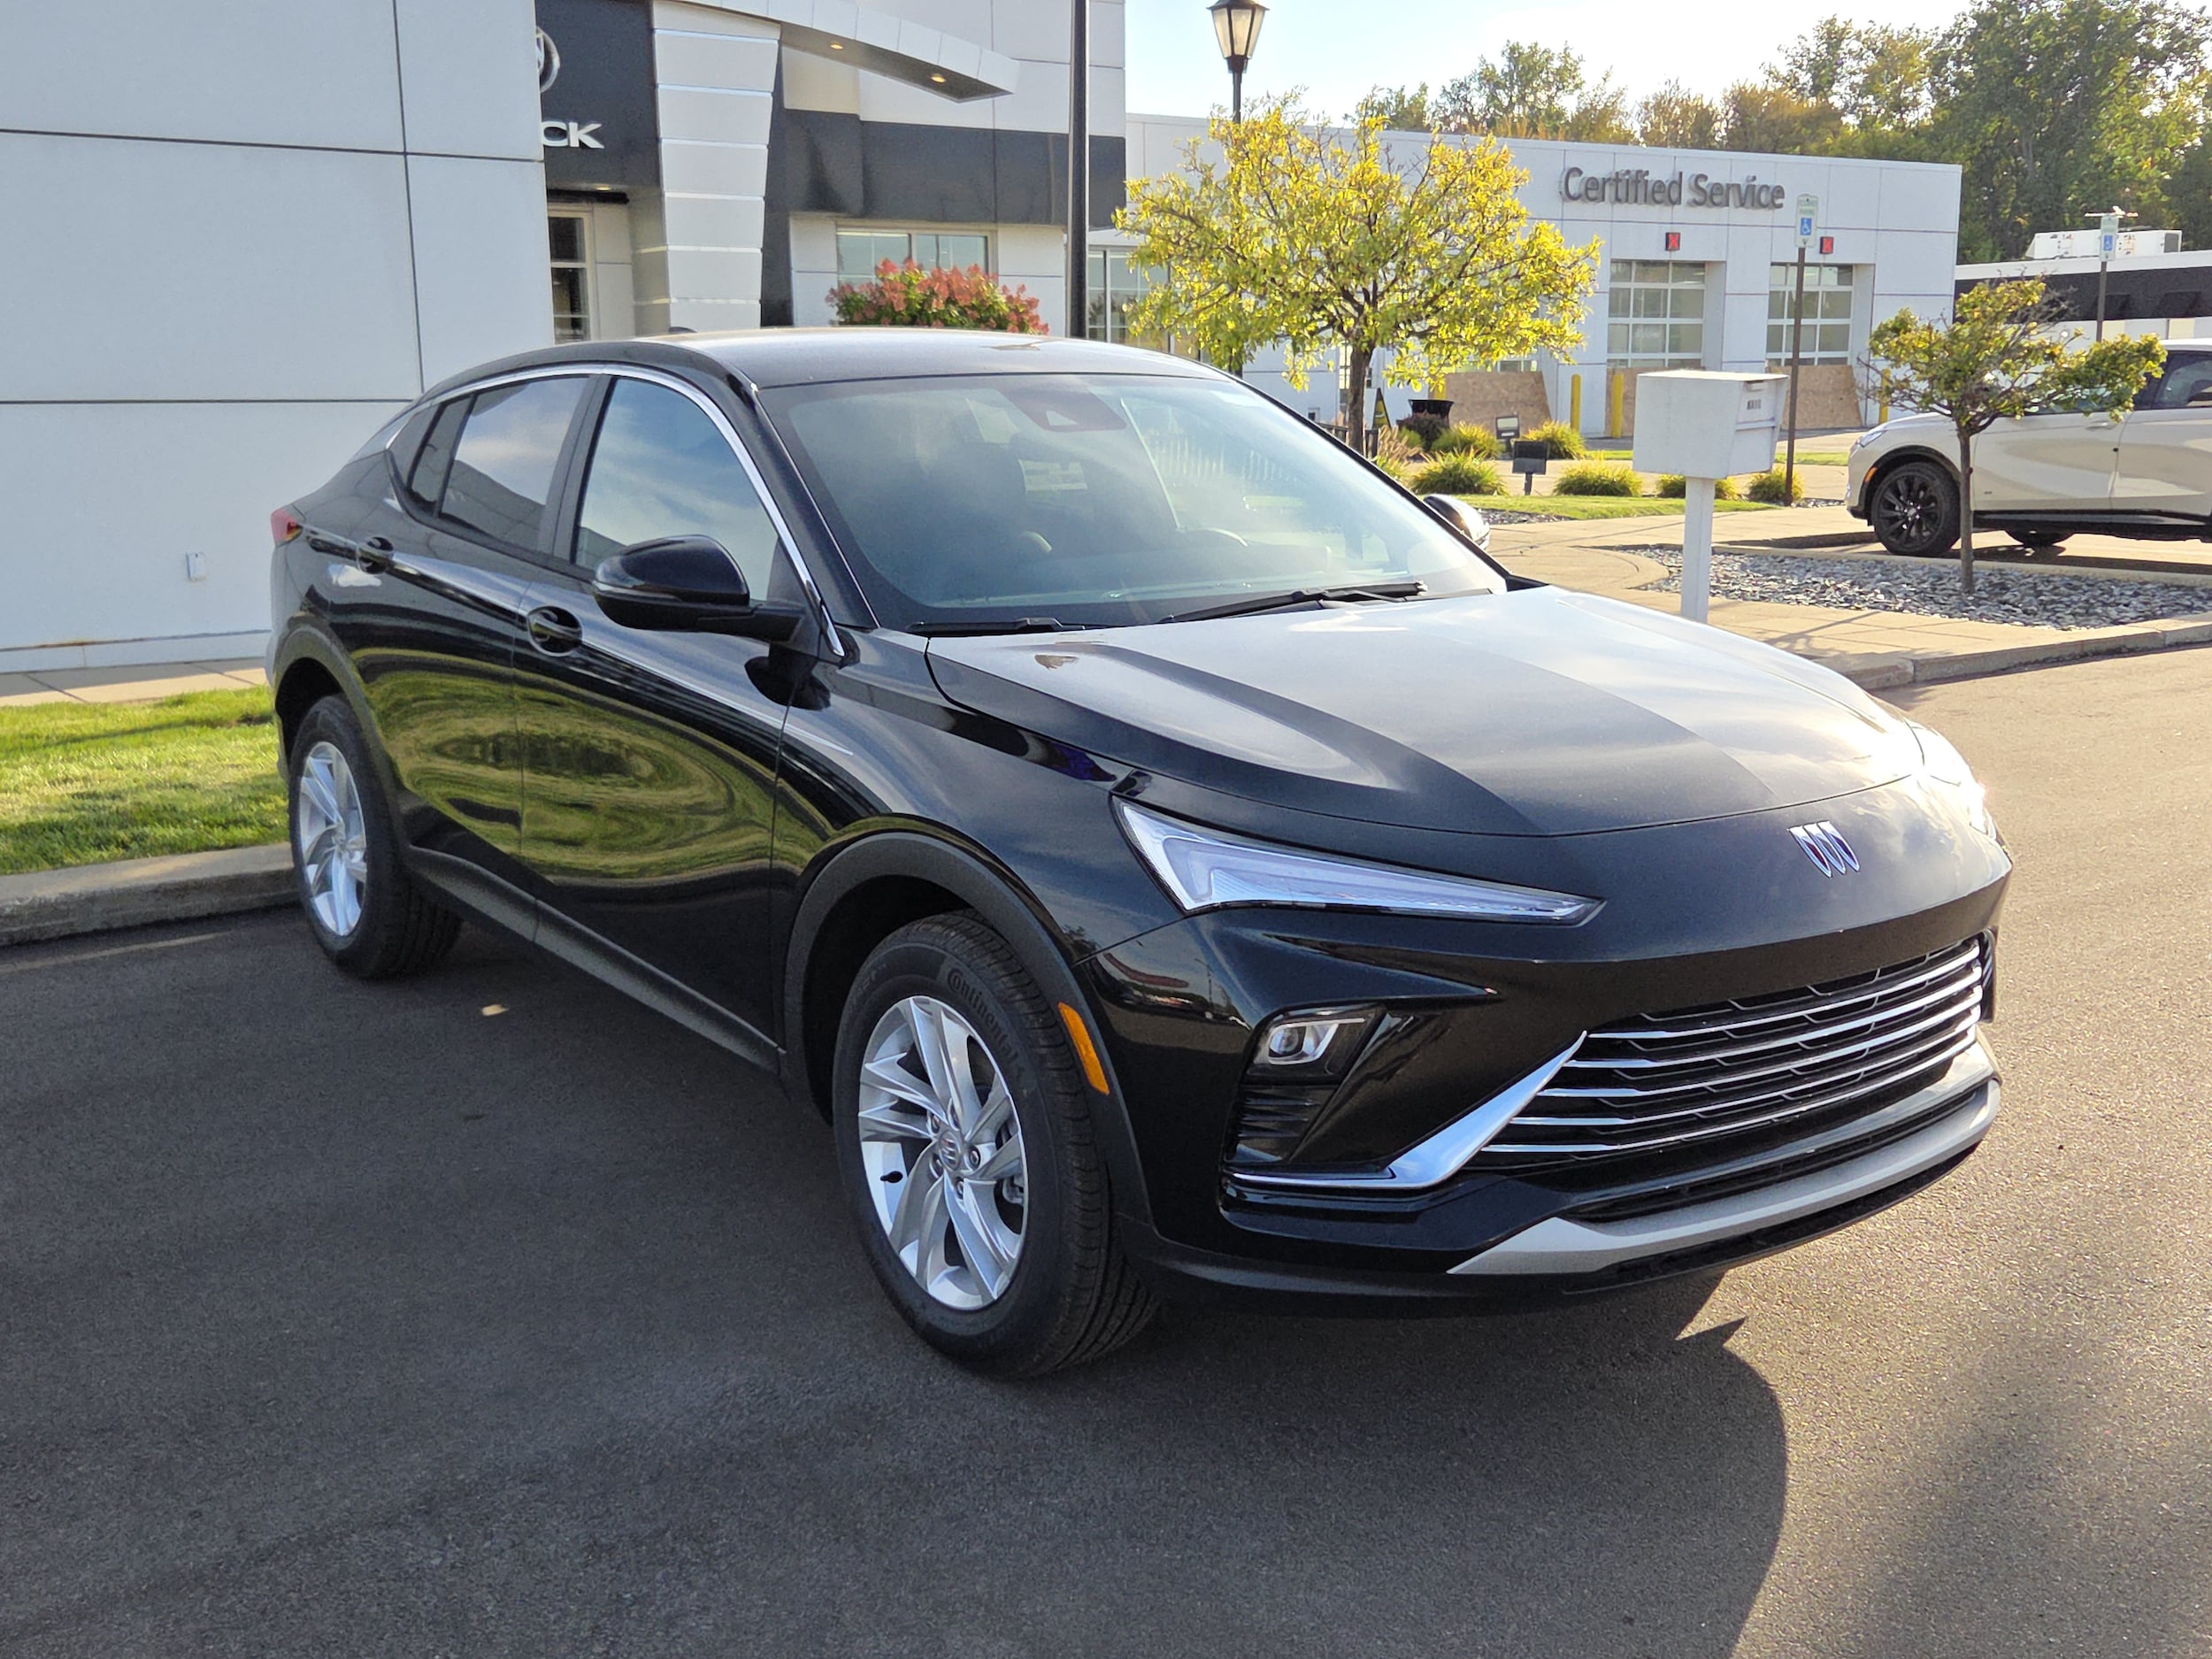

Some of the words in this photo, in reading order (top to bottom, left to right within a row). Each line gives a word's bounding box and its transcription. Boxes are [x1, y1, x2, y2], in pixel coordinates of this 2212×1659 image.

[541, 120, 604, 149] CK
[1561, 166, 1683, 206] Certified
[1688, 173, 1786, 210] Service
[947, 968, 1019, 1064] Continental
